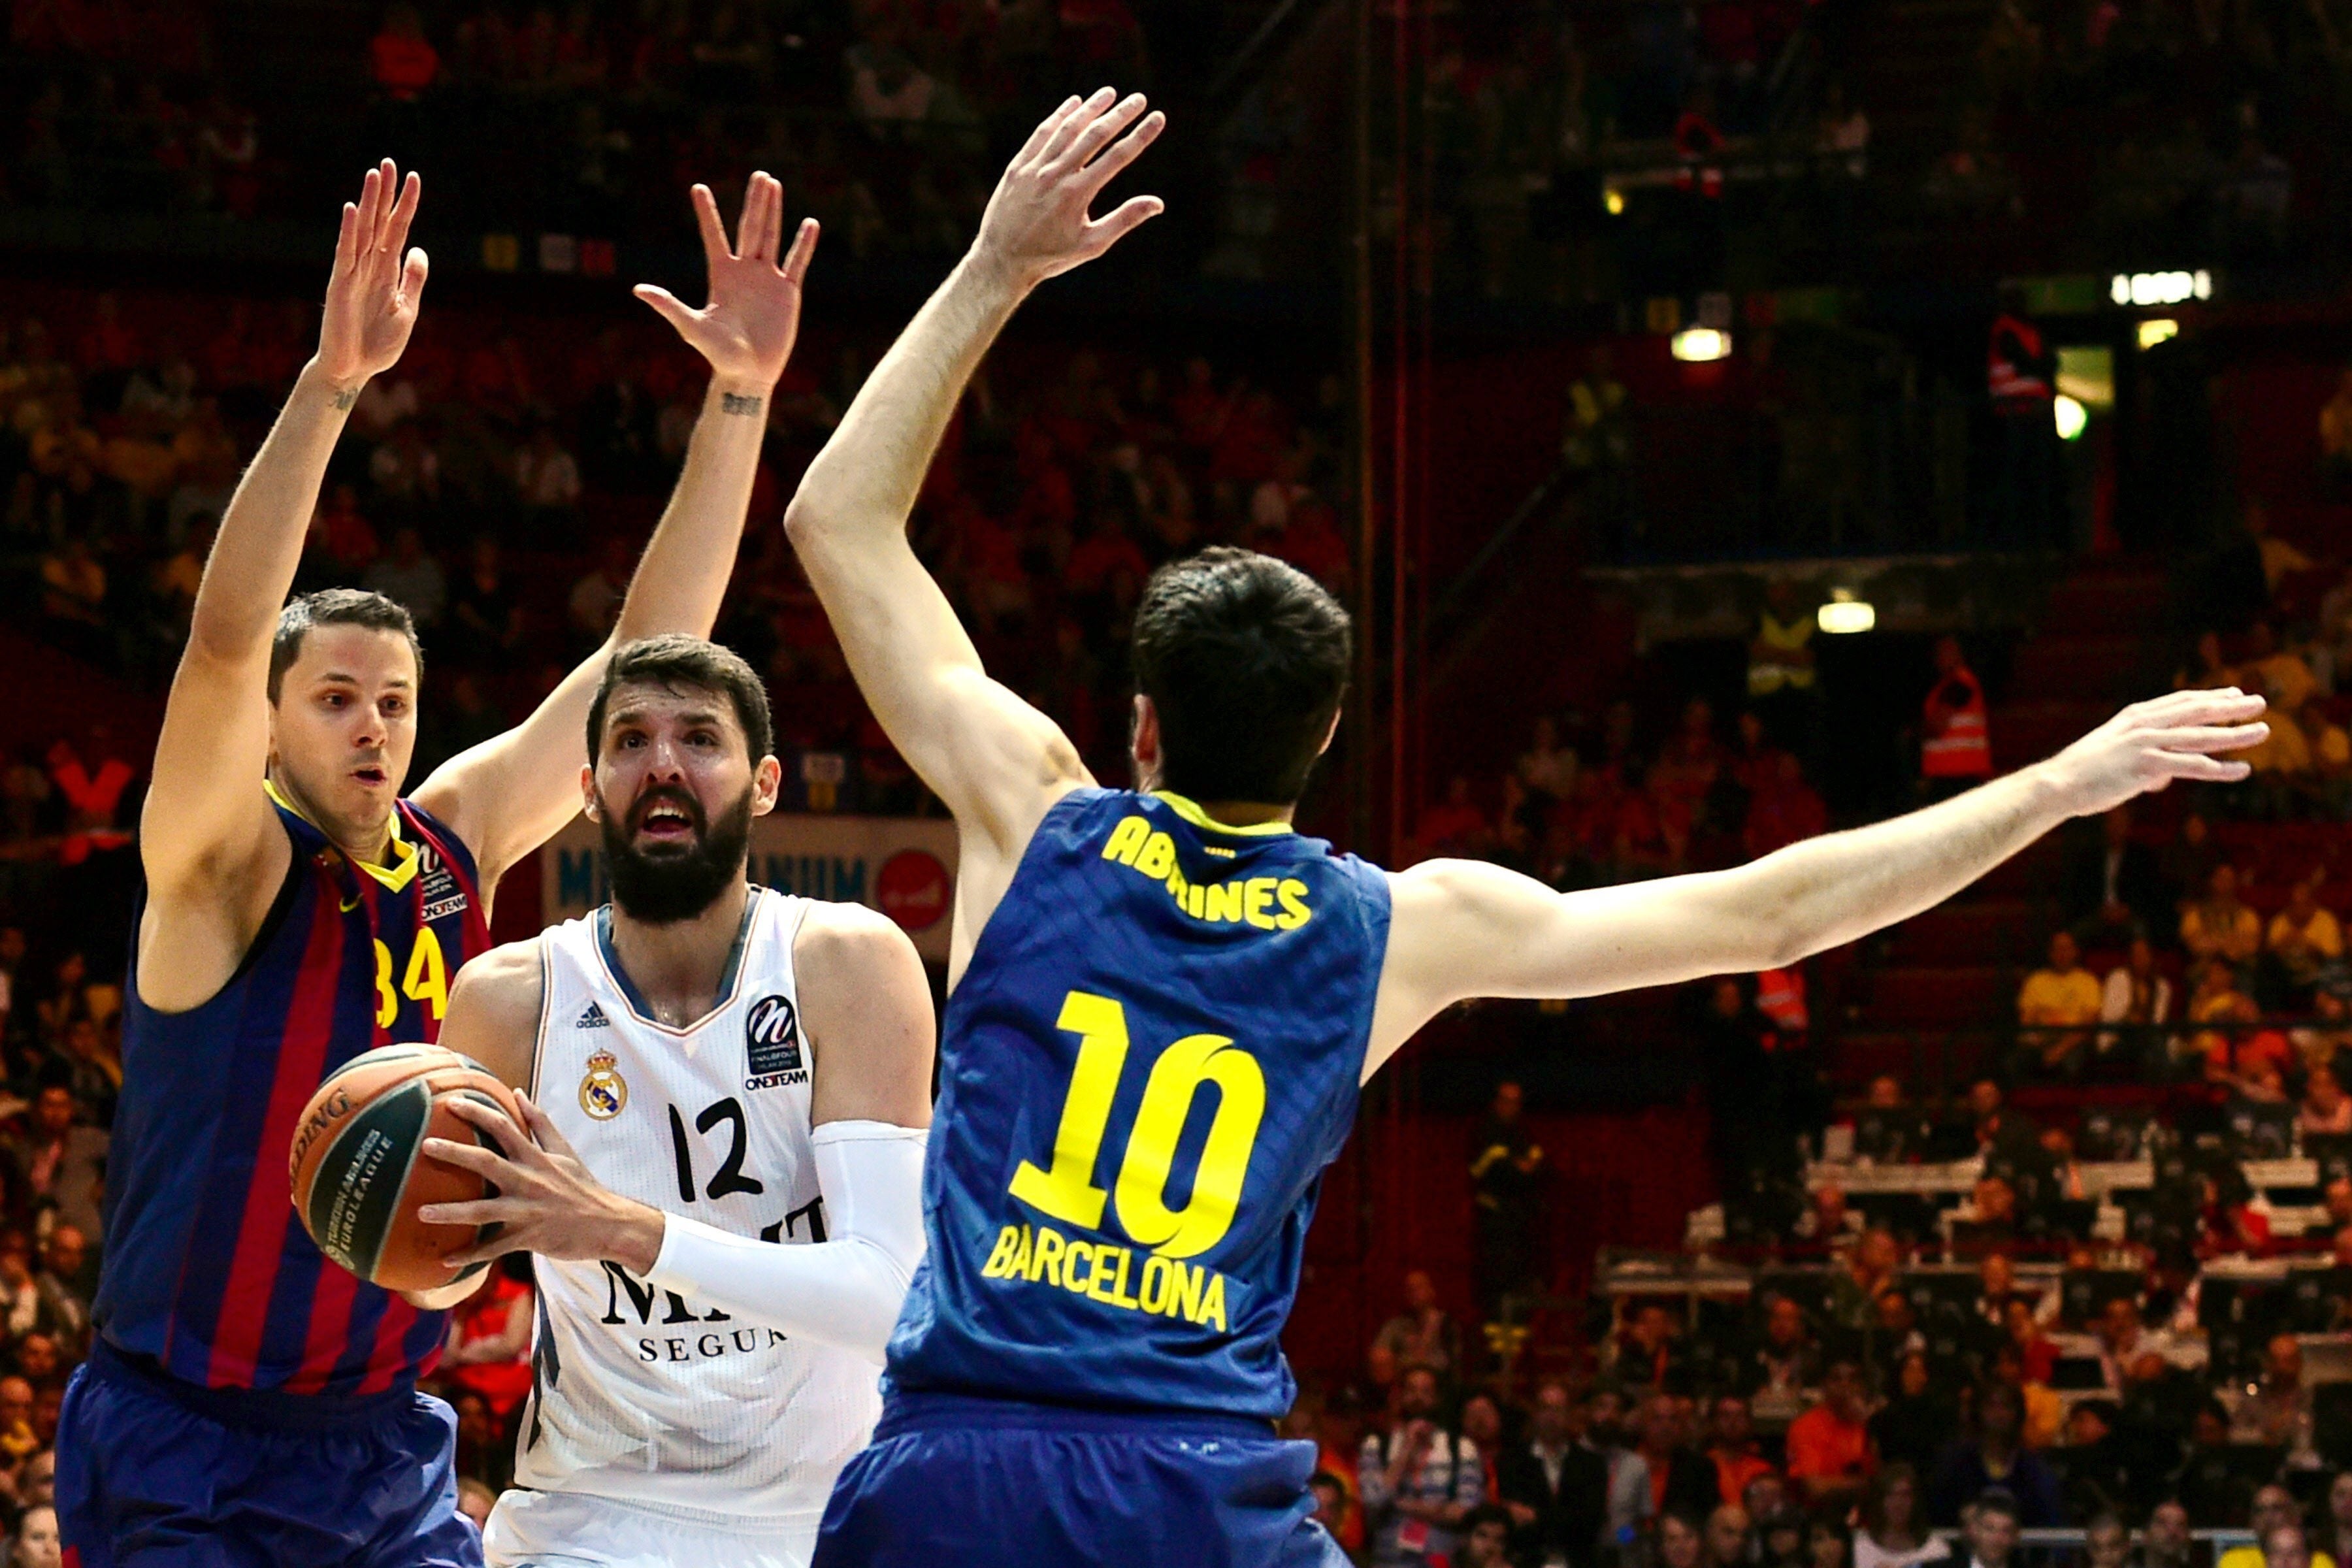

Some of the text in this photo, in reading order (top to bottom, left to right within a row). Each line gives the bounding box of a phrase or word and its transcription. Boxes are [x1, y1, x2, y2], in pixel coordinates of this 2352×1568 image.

[668, 1097, 764, 1202] 12
[1008, 990, 1266, 1258] 10
[982, 1223, 1226, 1332] BARCELONA
